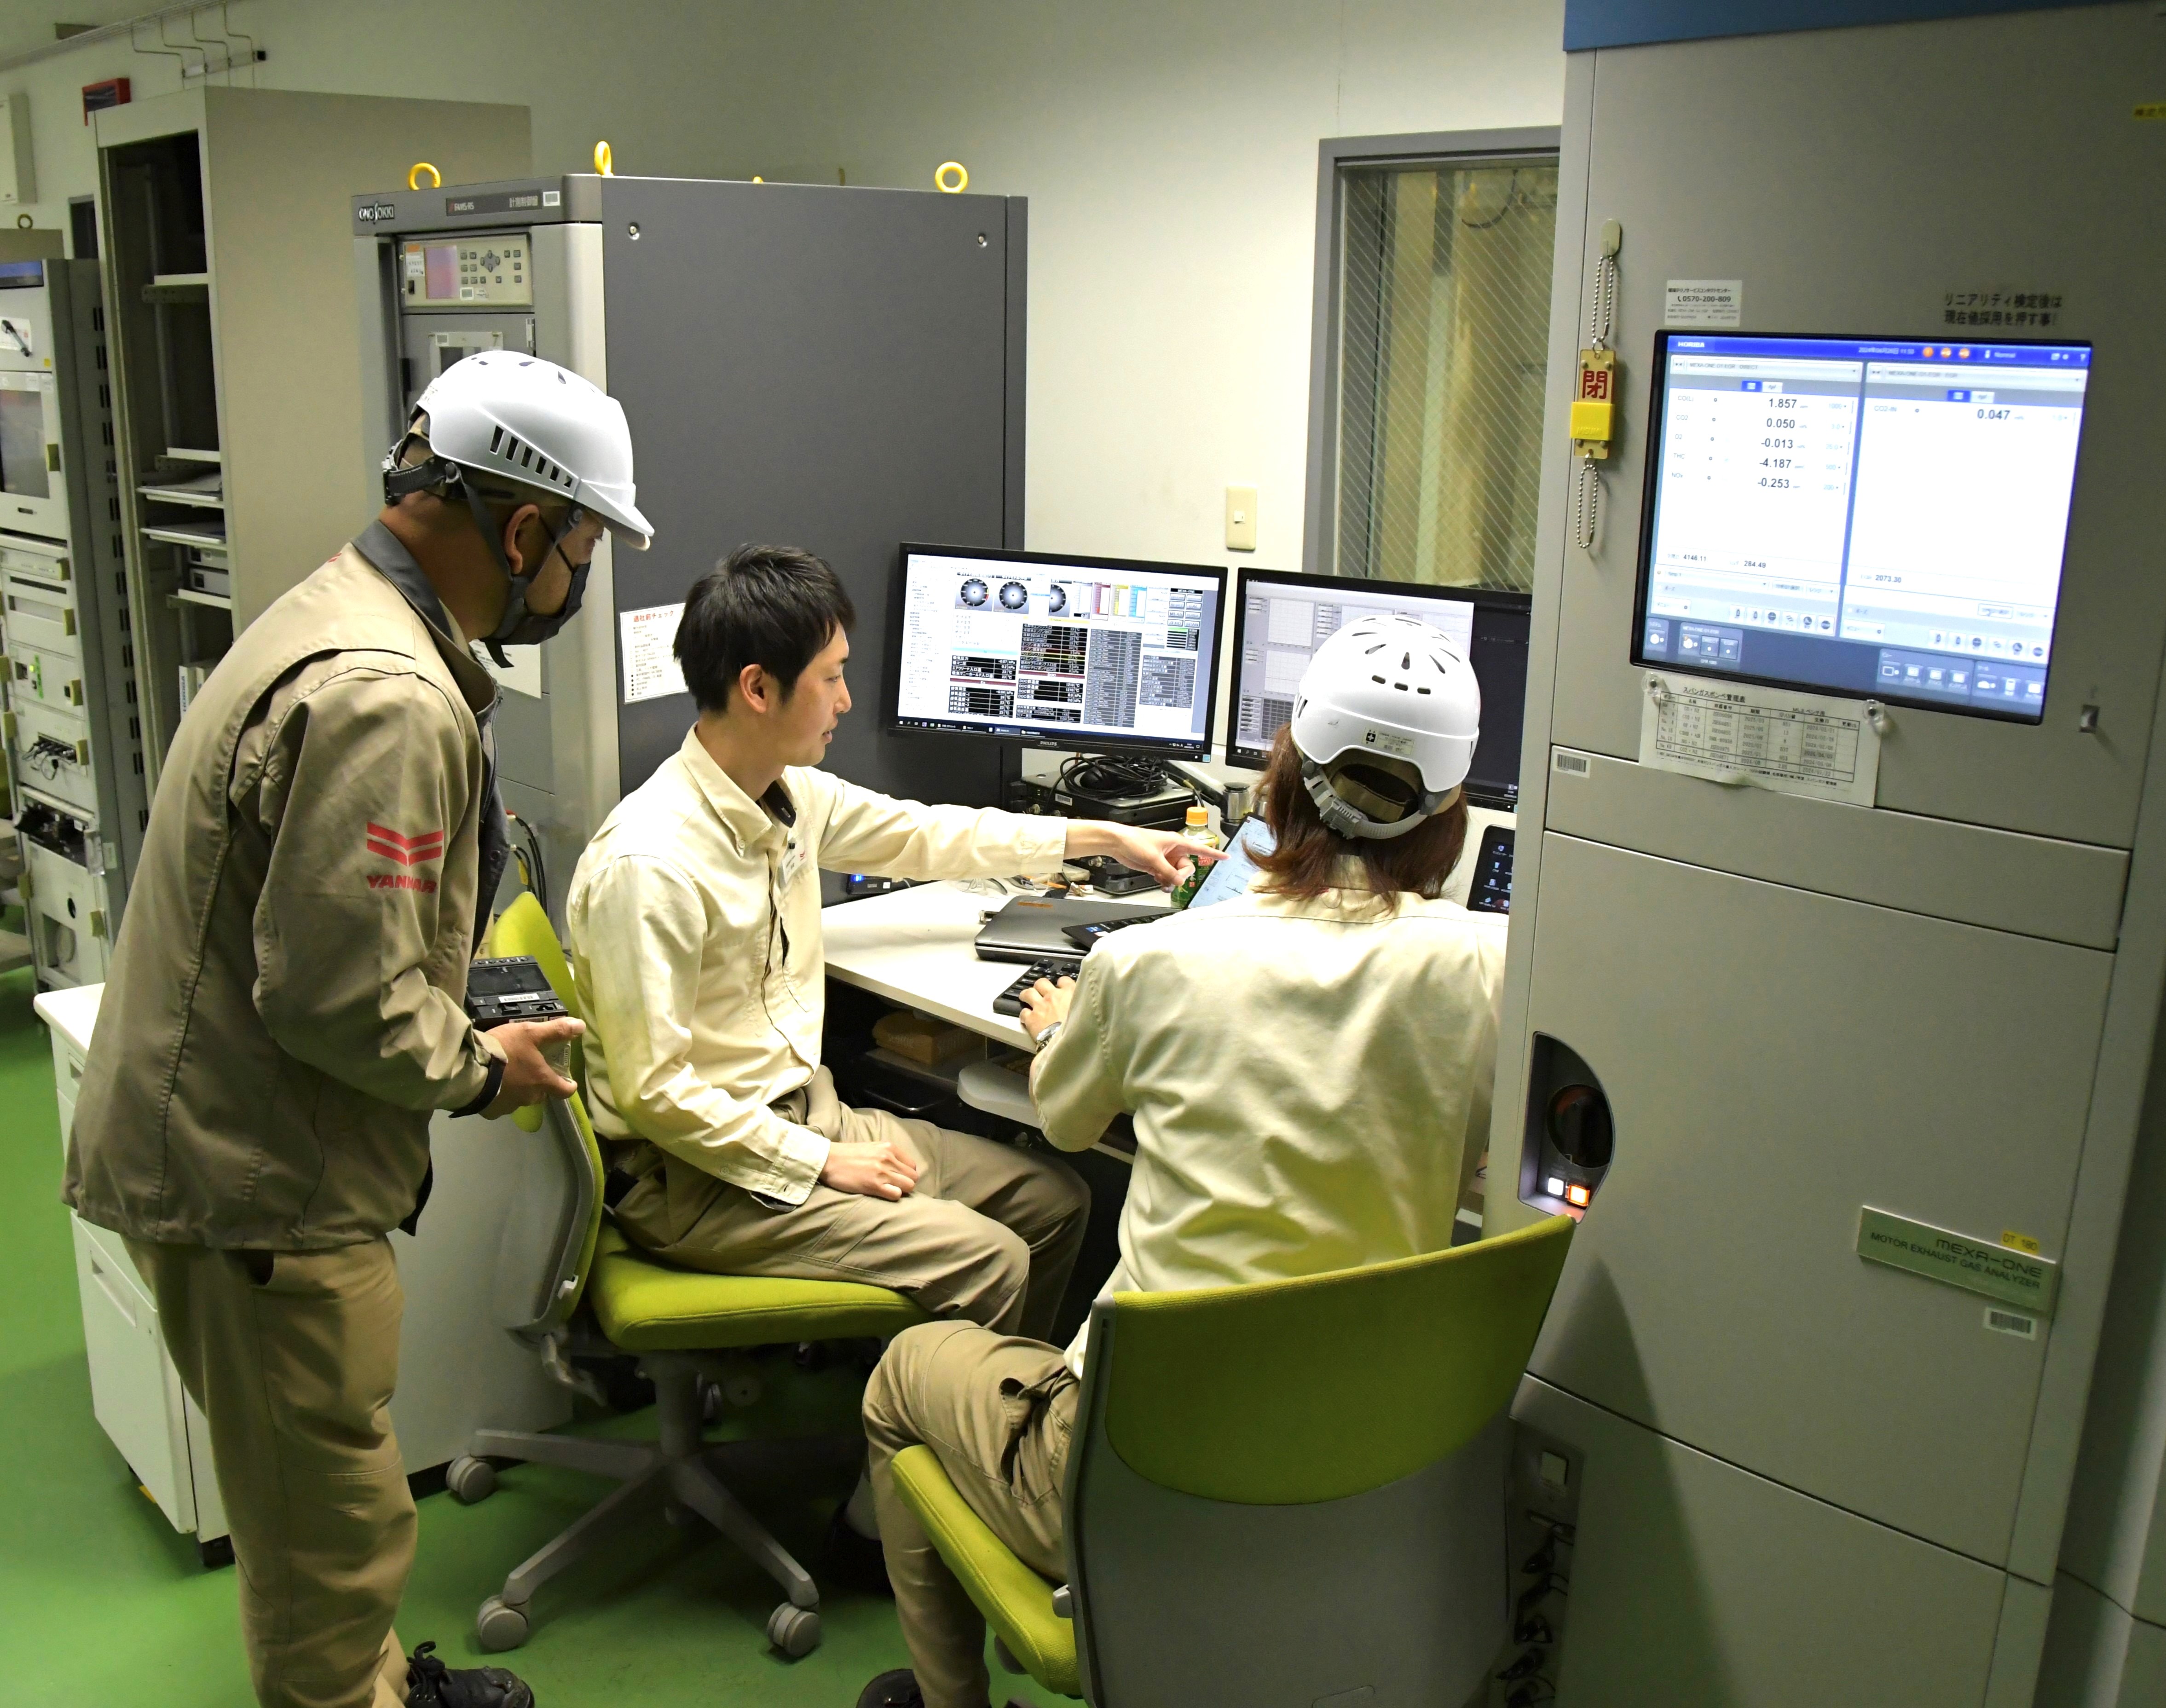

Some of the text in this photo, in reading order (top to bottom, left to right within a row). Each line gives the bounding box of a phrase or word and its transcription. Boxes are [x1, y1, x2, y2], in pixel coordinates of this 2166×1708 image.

[1582, 370, 1608, 399] 閉
[1769, 398, 1797, 409] 1.857
[1977, 409, 2010, 421] 0.047
[1766, 418, 1796, 429] 0.050
[1761, 438, 1794, 449] -0.013
[1759, 458, 1791, 469] -4.187
[1757, 478, 1790, 489] -0.253
[1744, 560, 1766, 569] 284.49
[1875, 574, 1902, 583] 2073.30
[1870, 1232, 2040, 1289] MOTOR EXHAUST GAS ANALYZER
[1936, 1239, 2043, 1277] MEXA-ONE
